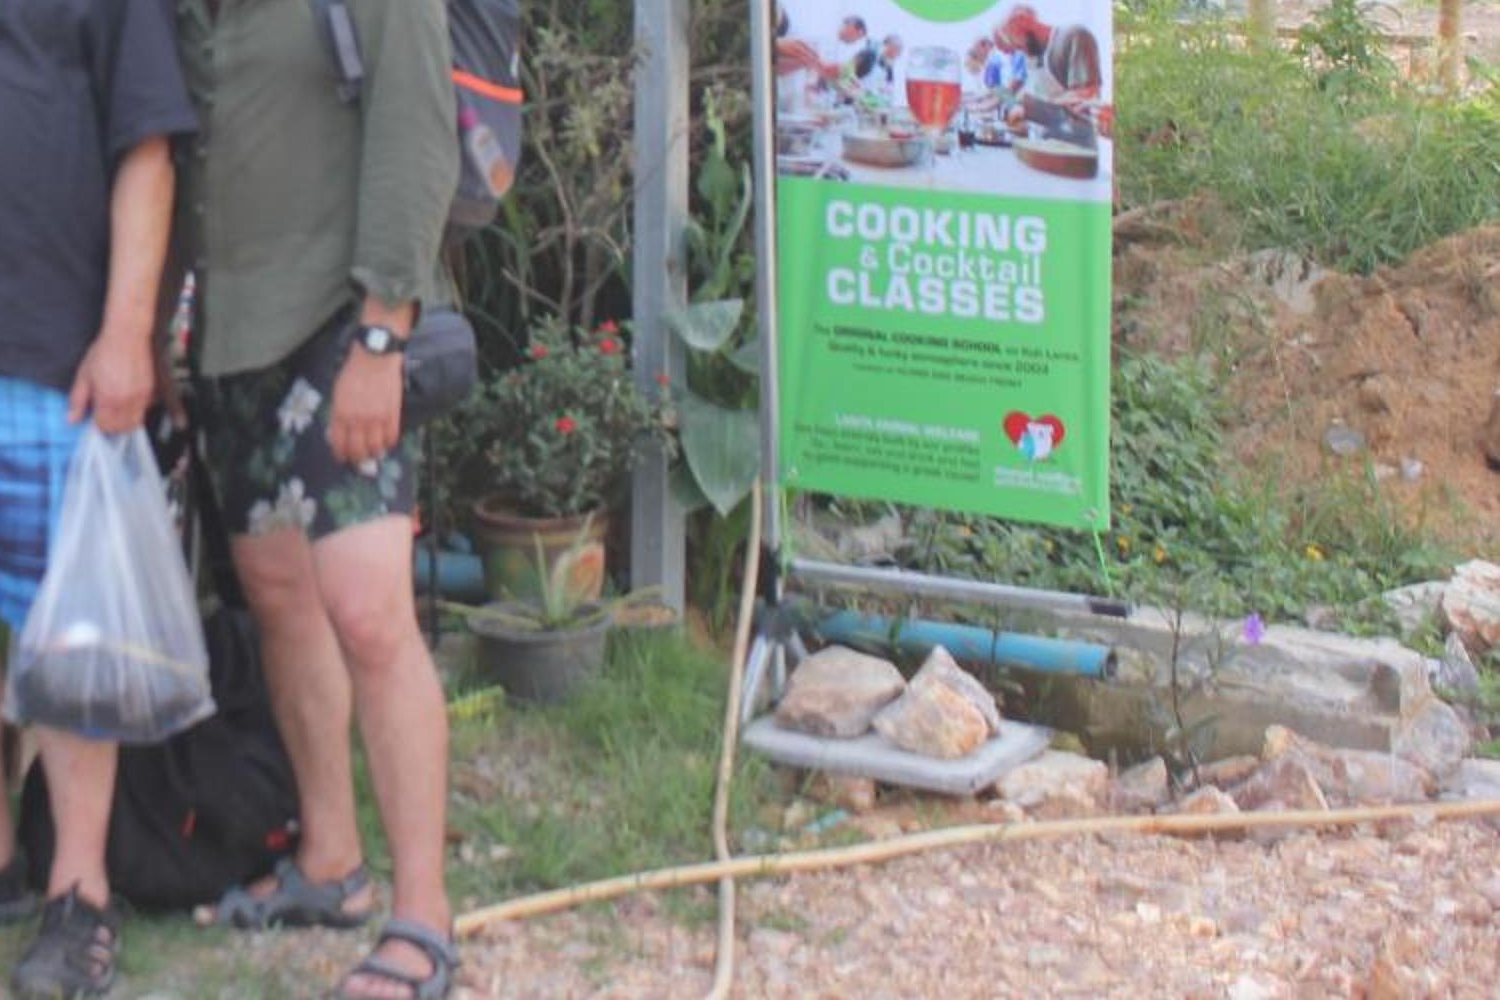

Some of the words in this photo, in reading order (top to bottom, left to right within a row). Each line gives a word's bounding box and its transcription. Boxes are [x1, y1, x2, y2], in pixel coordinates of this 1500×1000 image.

[826, 200, 1048, 253] COOKING
[888, 241, 1042, 285] Cocktail
[826, 268, 1045, 324] CLASSES
